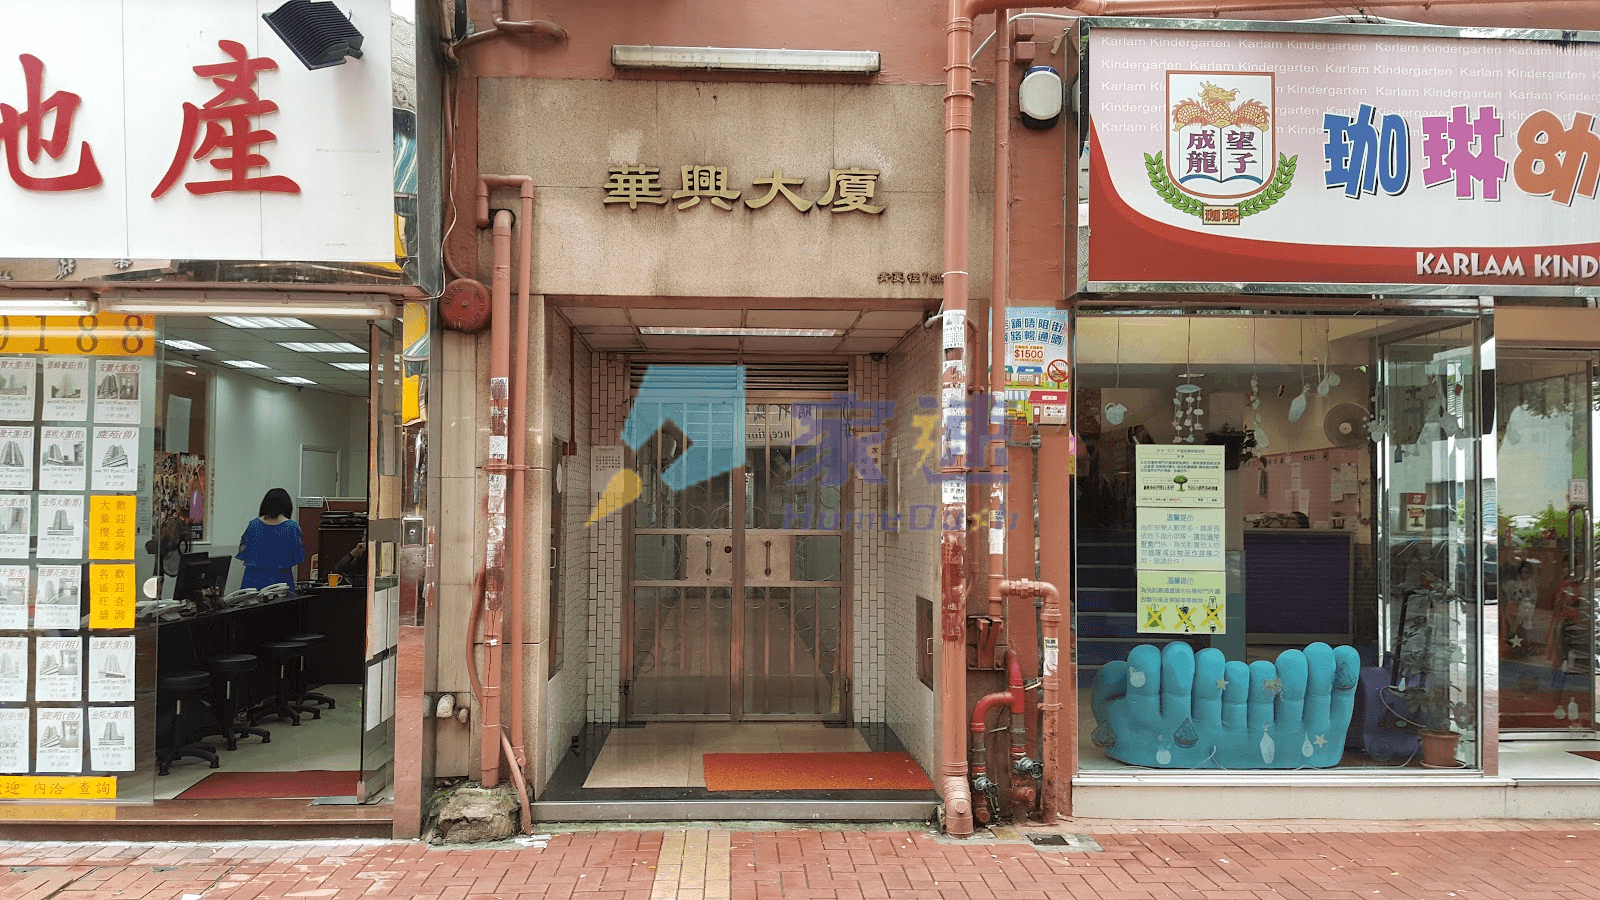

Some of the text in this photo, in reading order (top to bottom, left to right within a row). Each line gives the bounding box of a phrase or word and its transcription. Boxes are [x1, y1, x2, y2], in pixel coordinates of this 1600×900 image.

[1101, 37, 1231, 49] Karlam Kindergarten
[1239, 39, 1367, 53] Karlam Kindergarten
[1375, 42, 1502, 56] Karlam Kindergarten
[1509, 45, 1552, 56] Karlam
[1101, 59, 1182, 72] Kindergarten
[1190, 61, 1319, 73] Karlam Kindergarten
[1325, 64, 1452, 77] Karlam Kindergarten
[1460, 67, 1586, 80] Karlam Kindergarten
[1101, 82, 1146, 92] Karlam
[1287, 84, 1367, 97] Kindergarten
[1376, 86, 1502, 100] Karlam Kindergarten
[1509, 90, 1552, 100] Karlam
[0, 40, 300, 200] 地產
[1101, 122, 1146, 133] Karlam
[1186, 129, 1218, 174] 成龍
[1226, 130, 1257, 173] 望子
[602, 164, 887, 214] 華興大廈
[1416, 251, 1525, 278] KARLAM
[1014, 349, 1044, 359] $1500
[79, 781, 111, 795] 查詢
